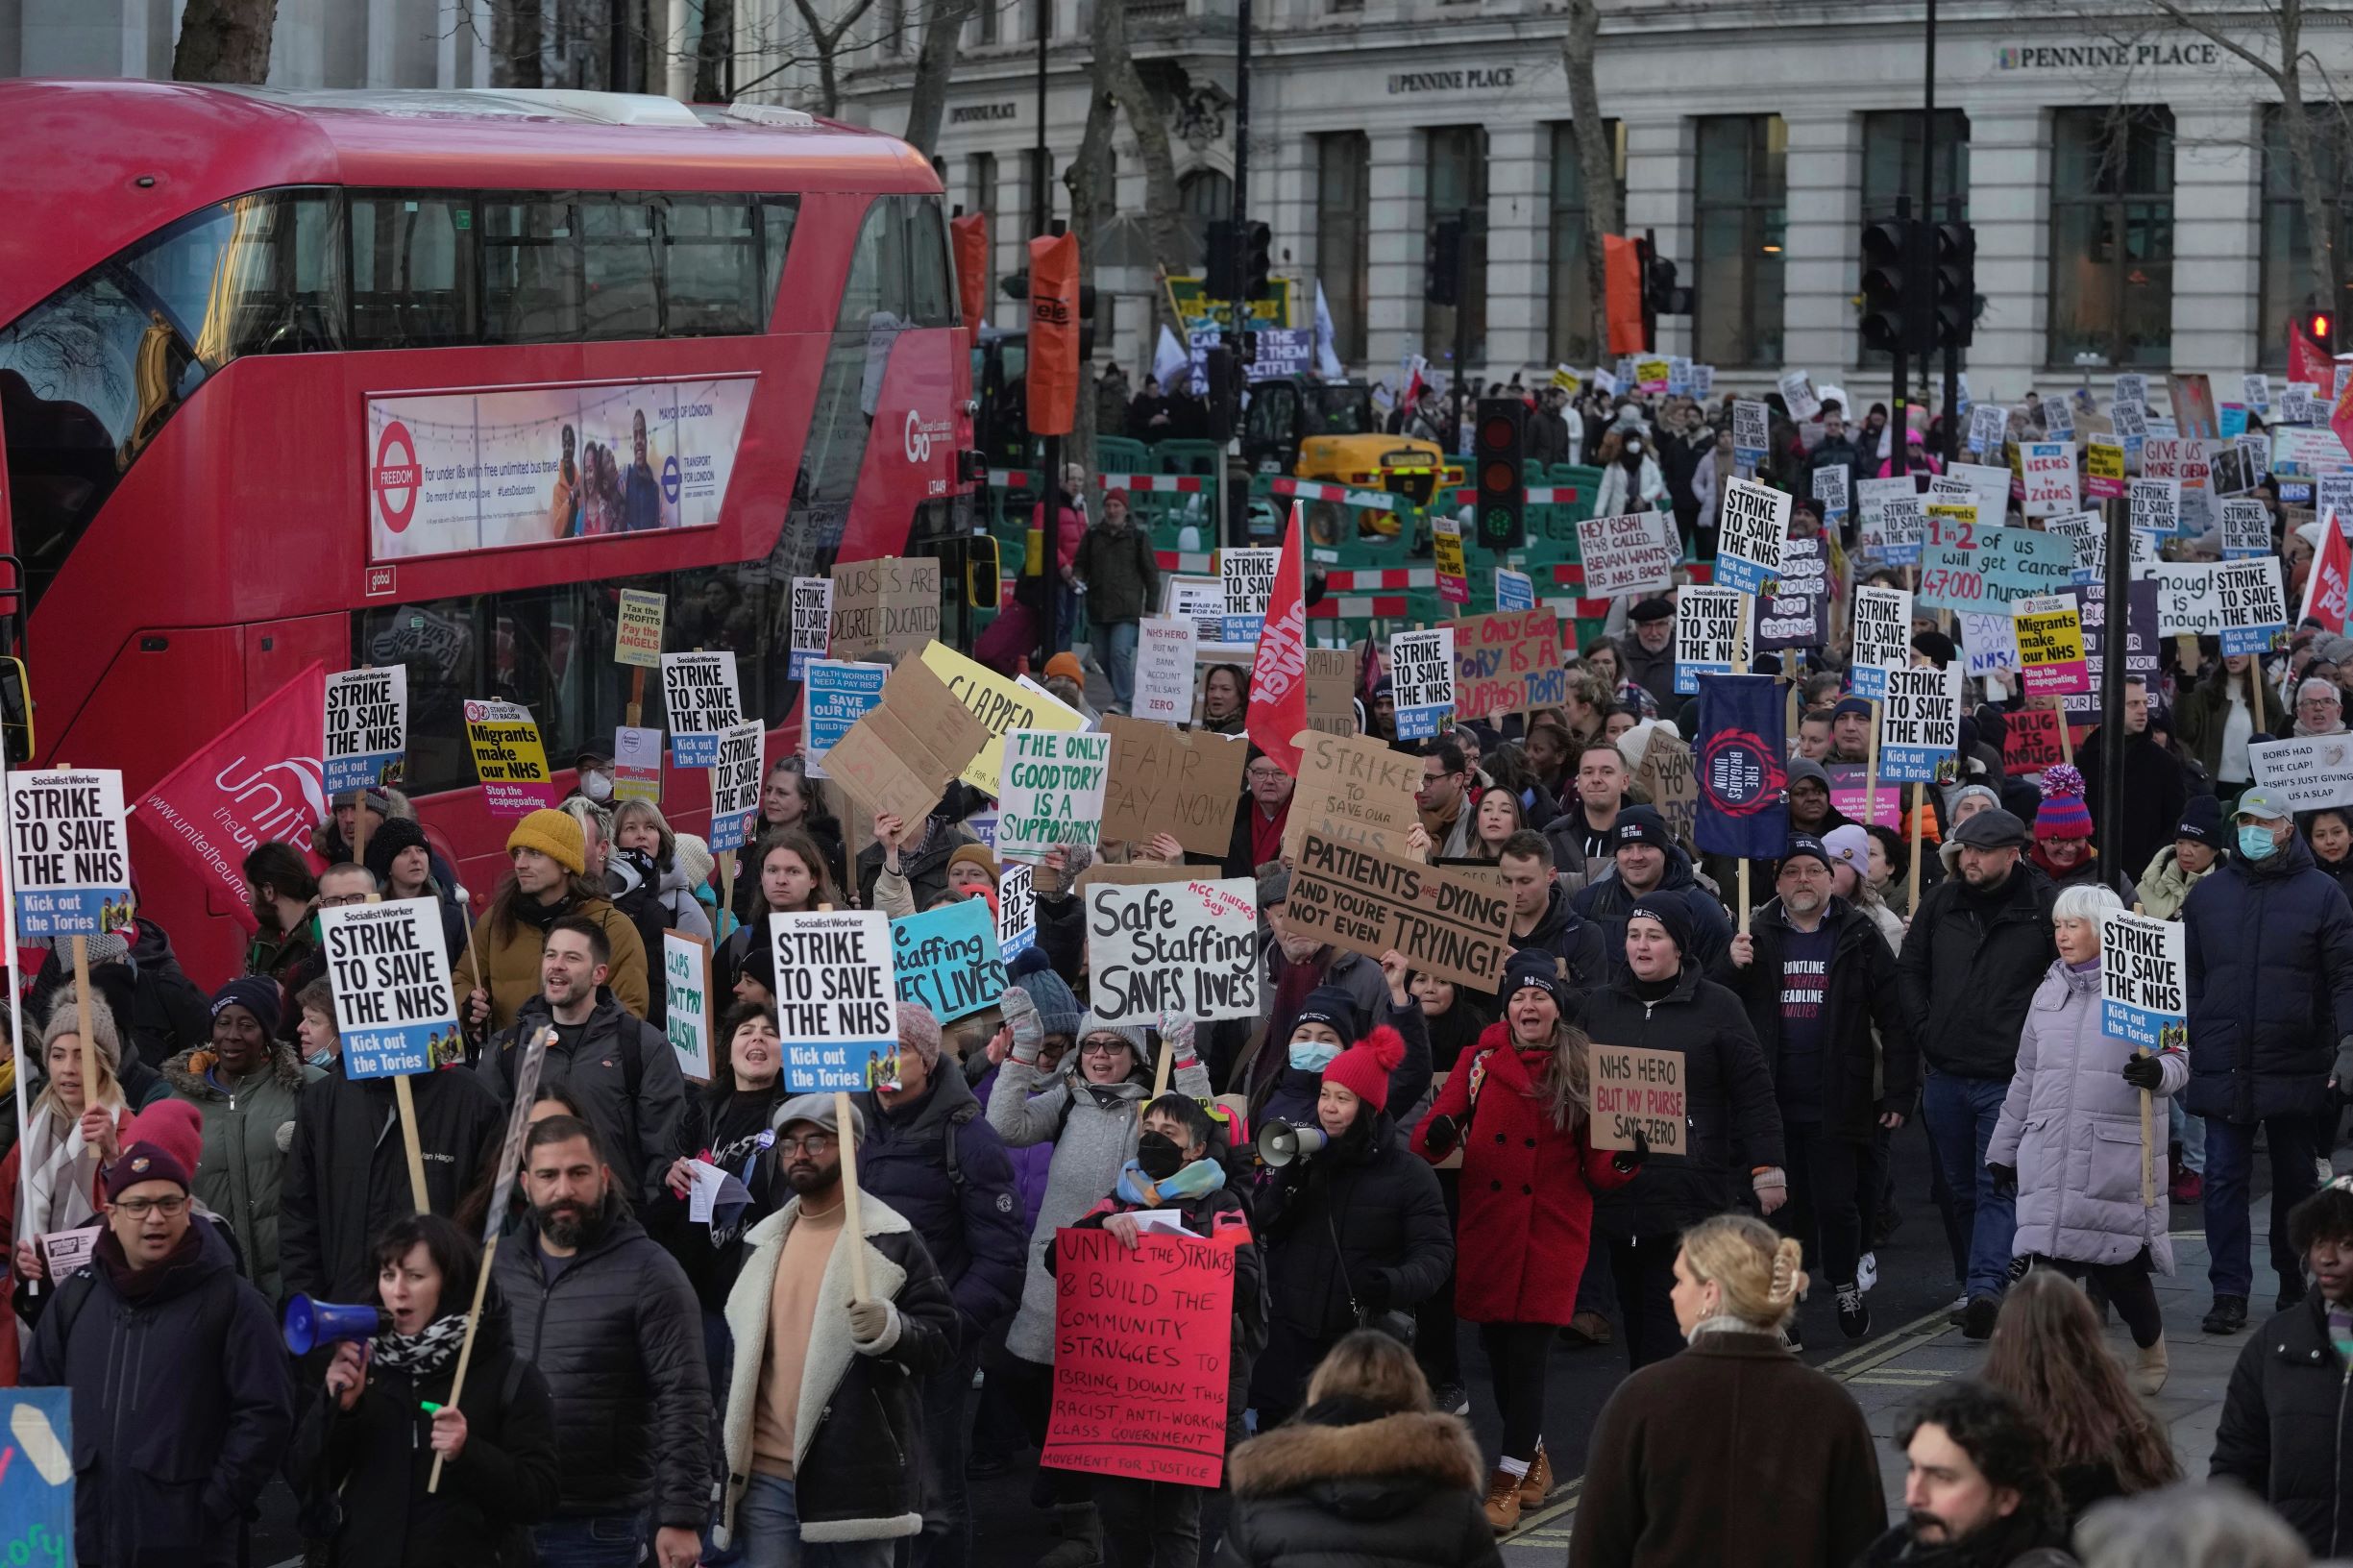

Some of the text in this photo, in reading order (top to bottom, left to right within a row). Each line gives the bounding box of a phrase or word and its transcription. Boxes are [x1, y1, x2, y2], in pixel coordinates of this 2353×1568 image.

[2022, 45, 2216, 67] PENNINE PLACE
[1401, 68, 1514, 92] PENNINE PLACE
[658, 404, 713, 420] MAYOR OF LONDON
[684, 455, 711, 467] TRANSPORT
[2145, 442, 2202, 459] GIVE US
[381, 470, 413, 485] FREEDOM
[425, 467, 434, 481] for
[437, 467, 455, 479] under
[484, 463, 498, 477] free
[501, 462, 528, 476] unlimited
[530, 461, 541, 474] bus
[684, 471, 714, 482] FOR LONDON
[2145, 464, 2175, 478] MORE
[1581, 515, 1642, 539] HEY RISHI
[1928, 522, 2034, 555] 1 in 2 of us
[1582, 538, 1607, 554] 1948
[1587, 548, 1669, 572] BEVAN WANTS
[1942, 552, 2073, 579] will get cancer
[372, 571, 390, 586] global
[838, 568, 938, 598] NURSES ARE
[1587, 561, 1667, 588] HIS NHS BACK!
[1924, 568, 1982, 600] 47,000
[623, 613, 660, 625] PROFITS
[626, 604, 642, 613] Tax
[623, 624, 658, 637] Pay the
[831, 606, 938, 640] DEGREE EDUCATED
[1146, 628, 1164, 638] NHS
[1164, 629, 1188, 640] HERO
[620, 635, 658, 649] ANGELS
[1152, 644, 1165, 652] BUT
[1147, 671, 1181, 680] ACCOUNT
[829, 695, 863, 707] SAVE
[1145, 685, 1181, 695] STILL SAYS
[815, 705, 842, 716] OUR
[1149, 699, 1174, 711] ZERO
[470, 725, 537, 746] Migrants
[1017, 733, 1107, 760] THE ONLY
[477, 746, 516, 762] make
[2263, 747, 2313, 759] BORIS HAD
[481, 763, 541, 779] our NHS
[1713, 758, 1728, 789] UNION
[1728, 751, 1743, 799] BRIGADES
[1744, 766, 1759, 788] FIRE
[2288, 761, 2313, 771] CLAP!
[2297, 776, 2318, 785] JUST
[2321, 773, 2353, 782] GIVING
[486, 786, 523, 797] Stop the
[489, 796, 546, 808] scapegoating
[2312, 789, 2334, 797] SLAP
[14, 788, 102, 820] STRIKE
[1034, 794, 1071, 818] IS A
[15, 821, 116, 852] TO SAVE
[999, 814, 1100, 845] SUPPOSITORY
[18, 852, 122, 885] THE NHS
[1303, 835, 1508, 928] PATIENTS ARE DYING
[1093, 889, 1177, 937] Safe
[1188, 882, 1256, 921] MCC nurses
[1203, 898, 1229, 917] say:
[1292, 879, 1387, 924] AND YOU'RE
[329, 919, 420, 958] STRIKE
[779, 932, 867, 965] STRIKE
[1131, 925, 1257, 974] Staffing
[1287, 902, 1501, 980] NOT EVEN TRYING!
[2104, 921, 2166, 958] STRIKE
[334, 951, 439, 992] TO SAVE
[2105, 947, 2176, 986] TO SAVE
[779, 967, 883, 1000] TO SAVE
[1094, 966, 1256, 1020] SAVES LIVES
[2105, 972, 2181, 1011] THE NHS
[339, 985, 449, 1025] THE NHS
[783, 1001, 890, 1036] THE NHS
[790, 1047, 846, 1065] Kick out
[792, 1068, 859, 1087] the Tories
[1600, 1055, 1676, 1085] NHS HERO
[1598, 1086, 1682, 1116] BUT MY PURSE
[1646, 1119, 1676, 1146] ZERO
[1061, 1273, 1216, 1311] & BUILD THE
[1061, 1311, 1189, 1340] COMMUNITY
[1059, 1369, 1185, 1395] BRING DOWN
